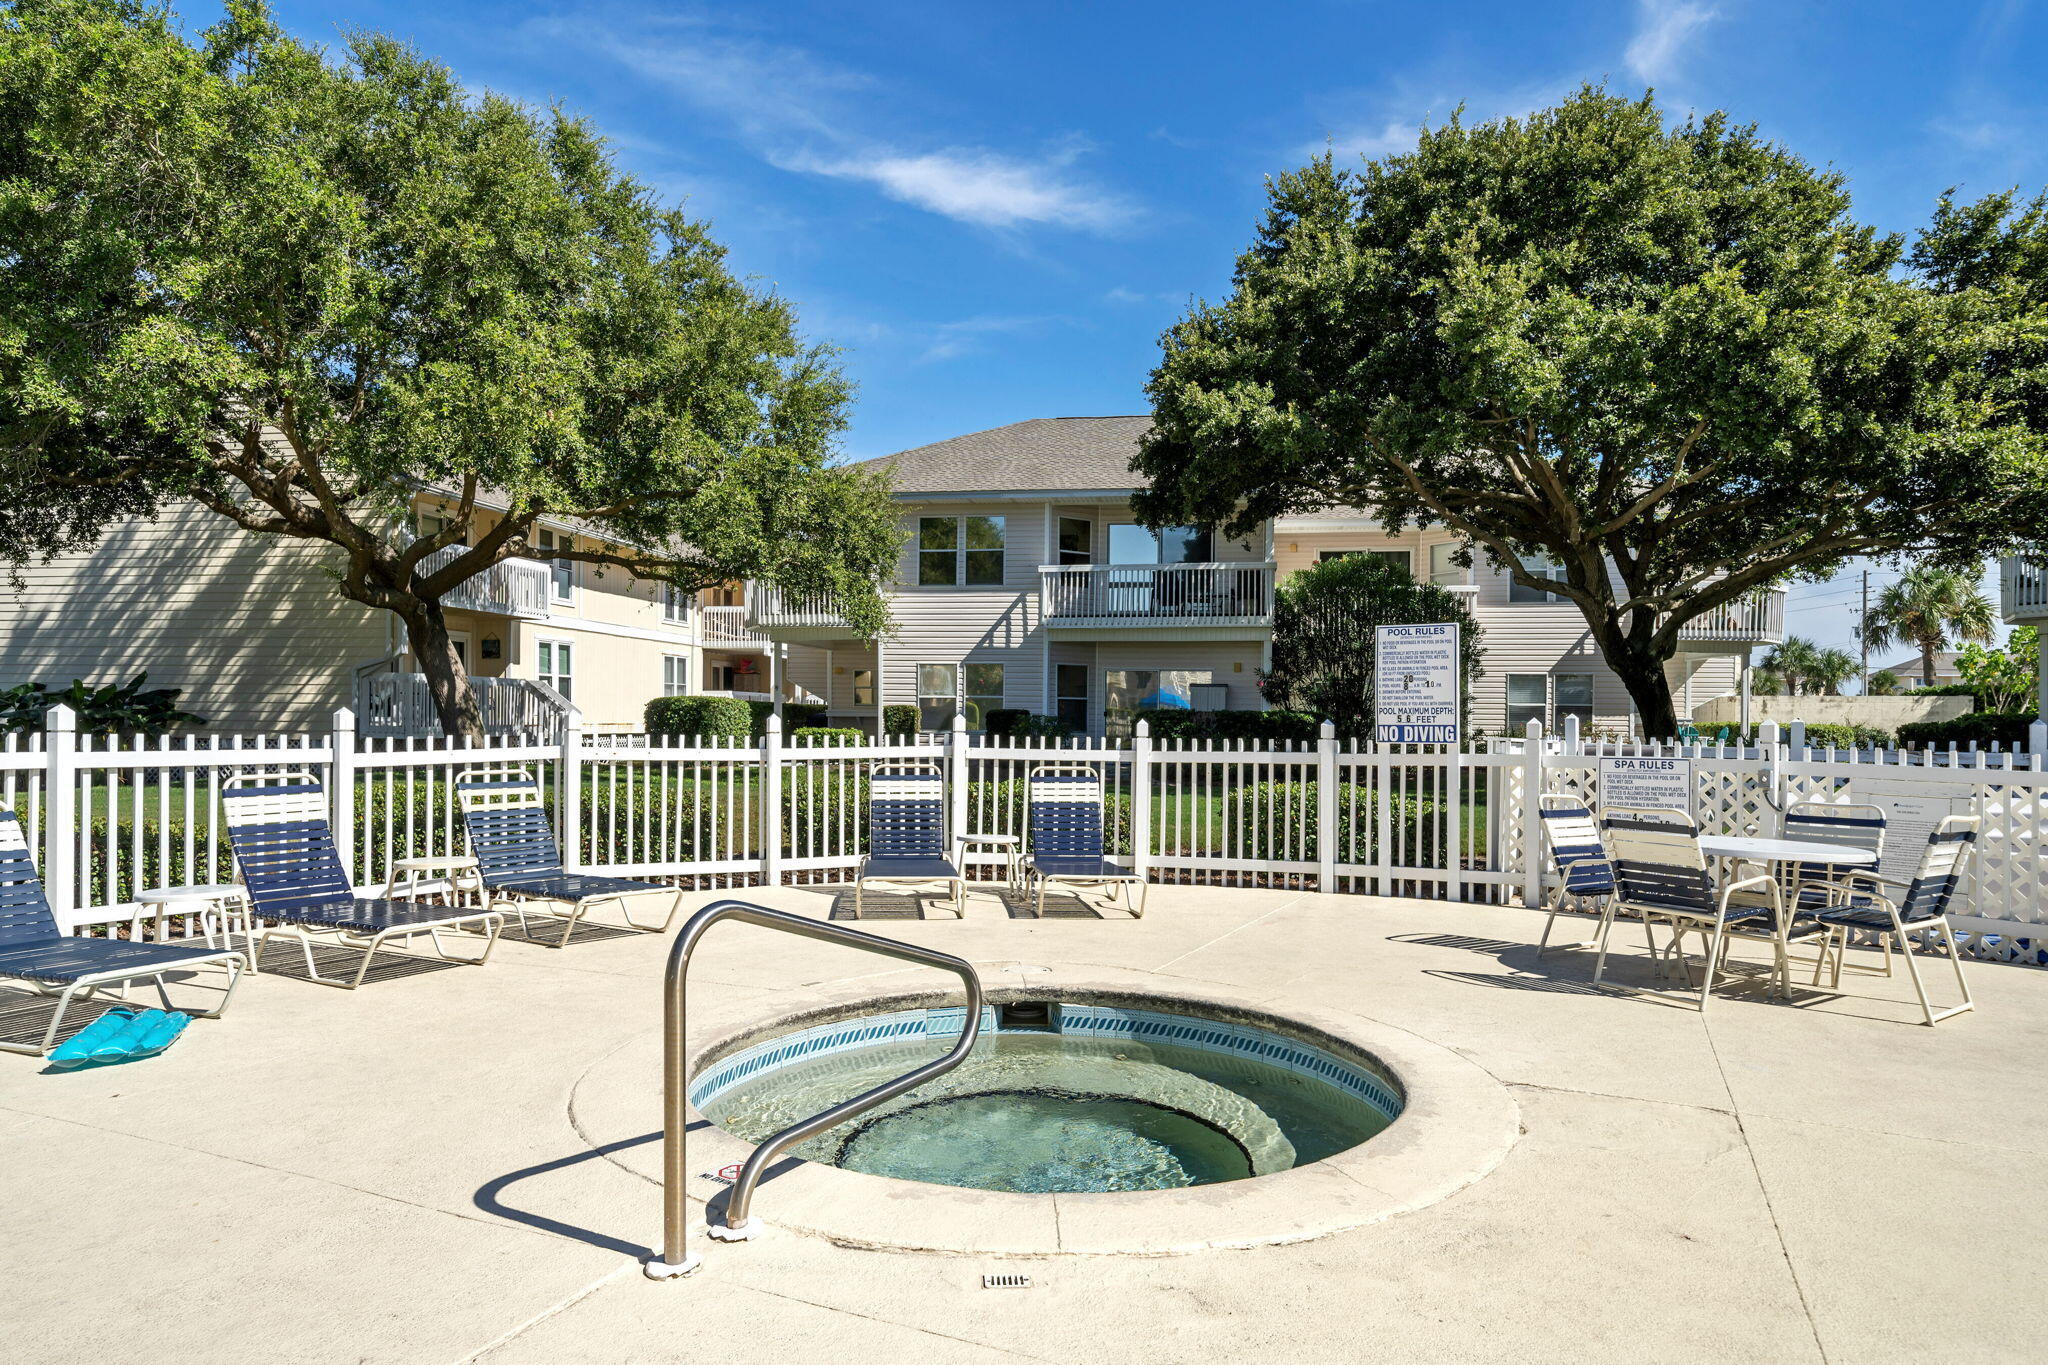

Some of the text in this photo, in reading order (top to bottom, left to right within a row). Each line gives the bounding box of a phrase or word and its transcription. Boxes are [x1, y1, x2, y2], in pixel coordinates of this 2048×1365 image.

[1379, 726, 1454, 742] NO DIVING
[1764, 749, 1769, 761] 1
[1614, 760, 1674, 769] SPA RULES
